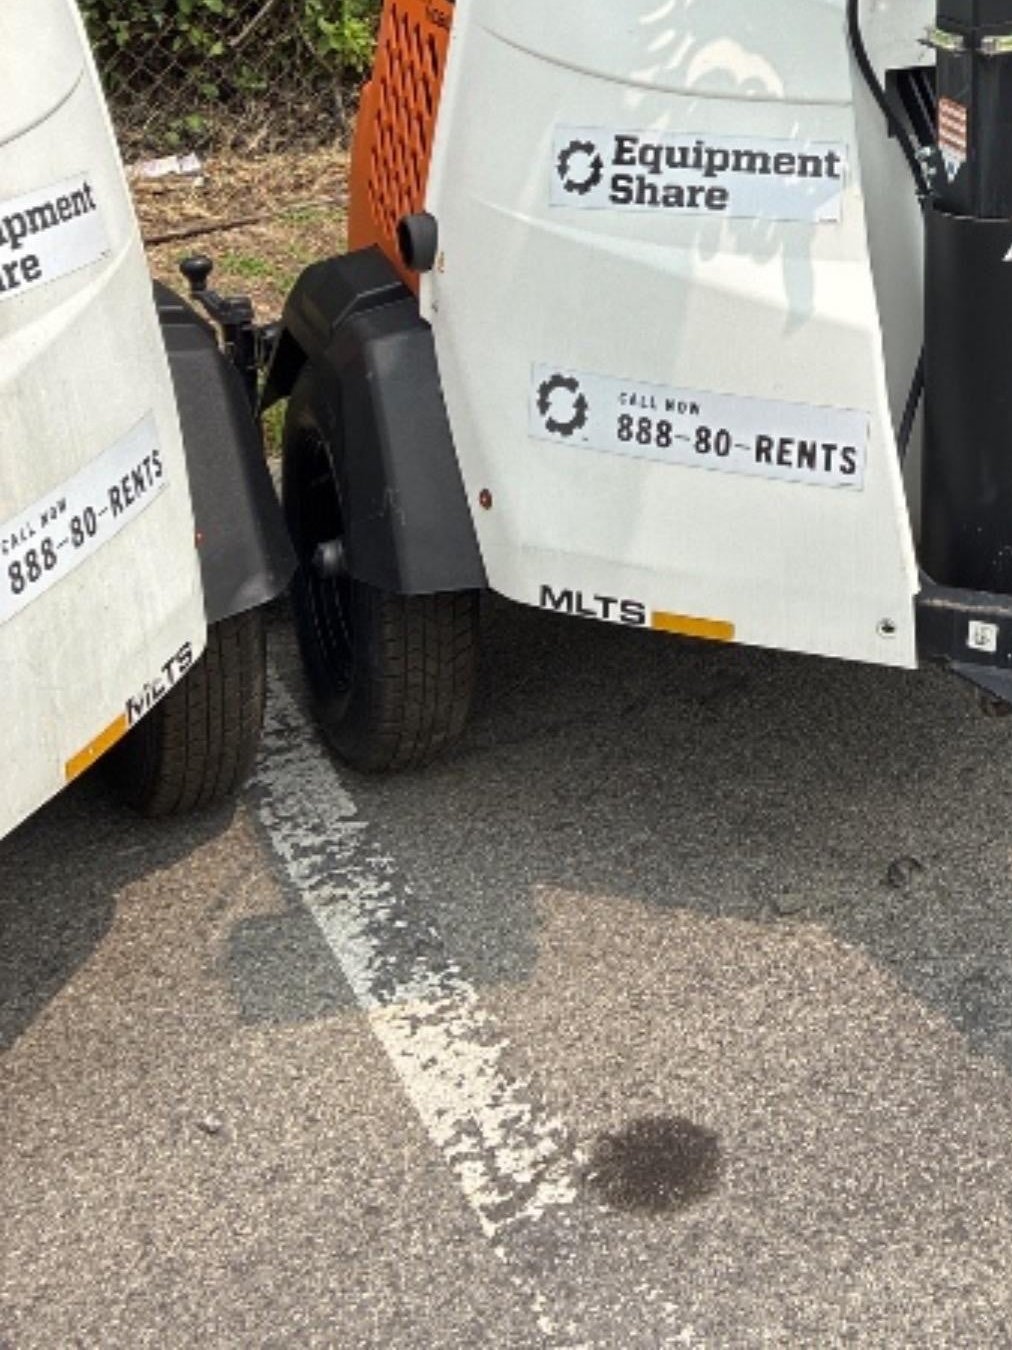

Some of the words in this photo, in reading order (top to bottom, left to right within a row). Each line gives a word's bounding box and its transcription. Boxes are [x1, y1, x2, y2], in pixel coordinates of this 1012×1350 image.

[612, 134, 841, 179] Equipment
[608, 173, 729, 210] Share
[618, 391, 657, 411] CALL
[664, 398, 701, 416] NOW
[616, 414, 858, 476] 888-80-RENTS
[1, 521, 37, 555] CALL
[39, 497, 67, 528] NOW
[8, 449, 164, 595] 888-80-RENTS
[539, 584, 646, 625] MLTS
